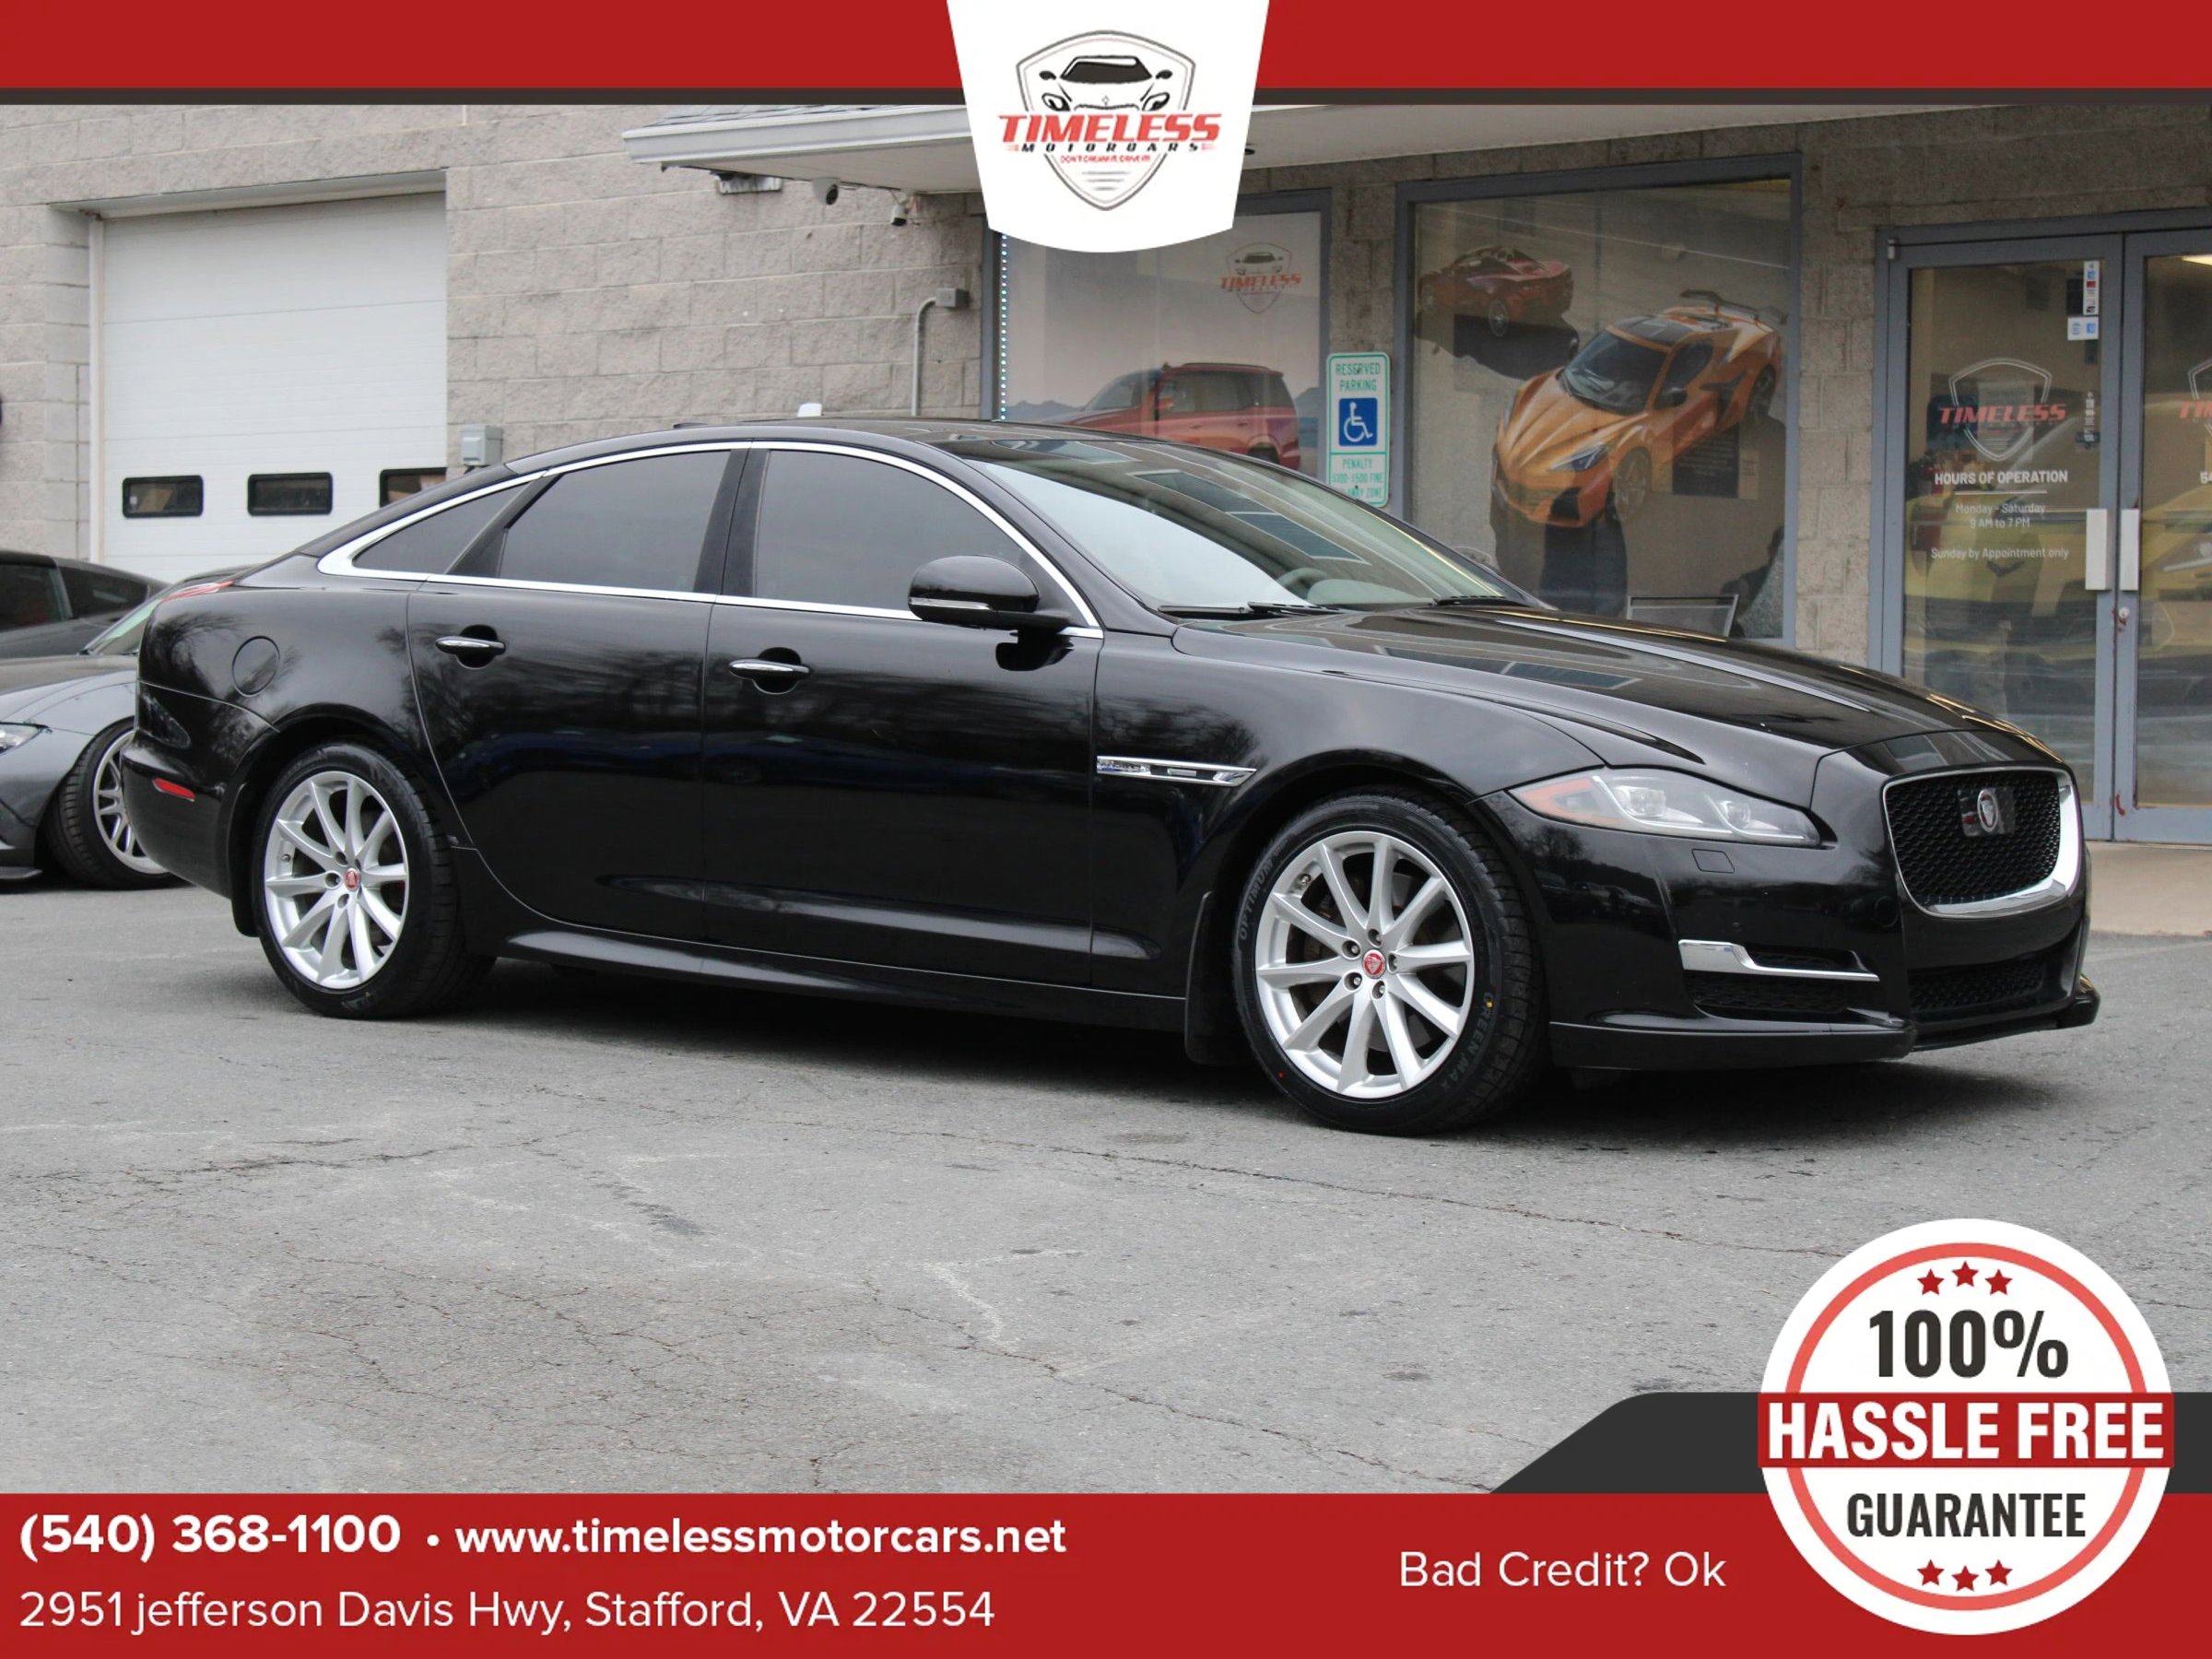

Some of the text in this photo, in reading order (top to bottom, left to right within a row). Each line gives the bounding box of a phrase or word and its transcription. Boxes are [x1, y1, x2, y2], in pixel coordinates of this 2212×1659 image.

[1220, 273, 1301, 288] TIMELESS
[1335, 362, 1381, 376] RESERVED
[1339, 380, 1377, 393] PARKING
[1939, 403, 2067, 425] TIMELESS
[1342, 458, 1372, 469] PENALTY
[1935, 470, 2068, 486] HOURS OF OPERATION
[1366, 487, 1383, 499] ZONE
[1956, 503, 1993, 516] Monday
[2001, 503, 2046, 515] Saturday
[1970, 518, 2030, 529] 9 AM to 7 PM
[1931, 547, 2069, 560] Sunday by Appointment only
